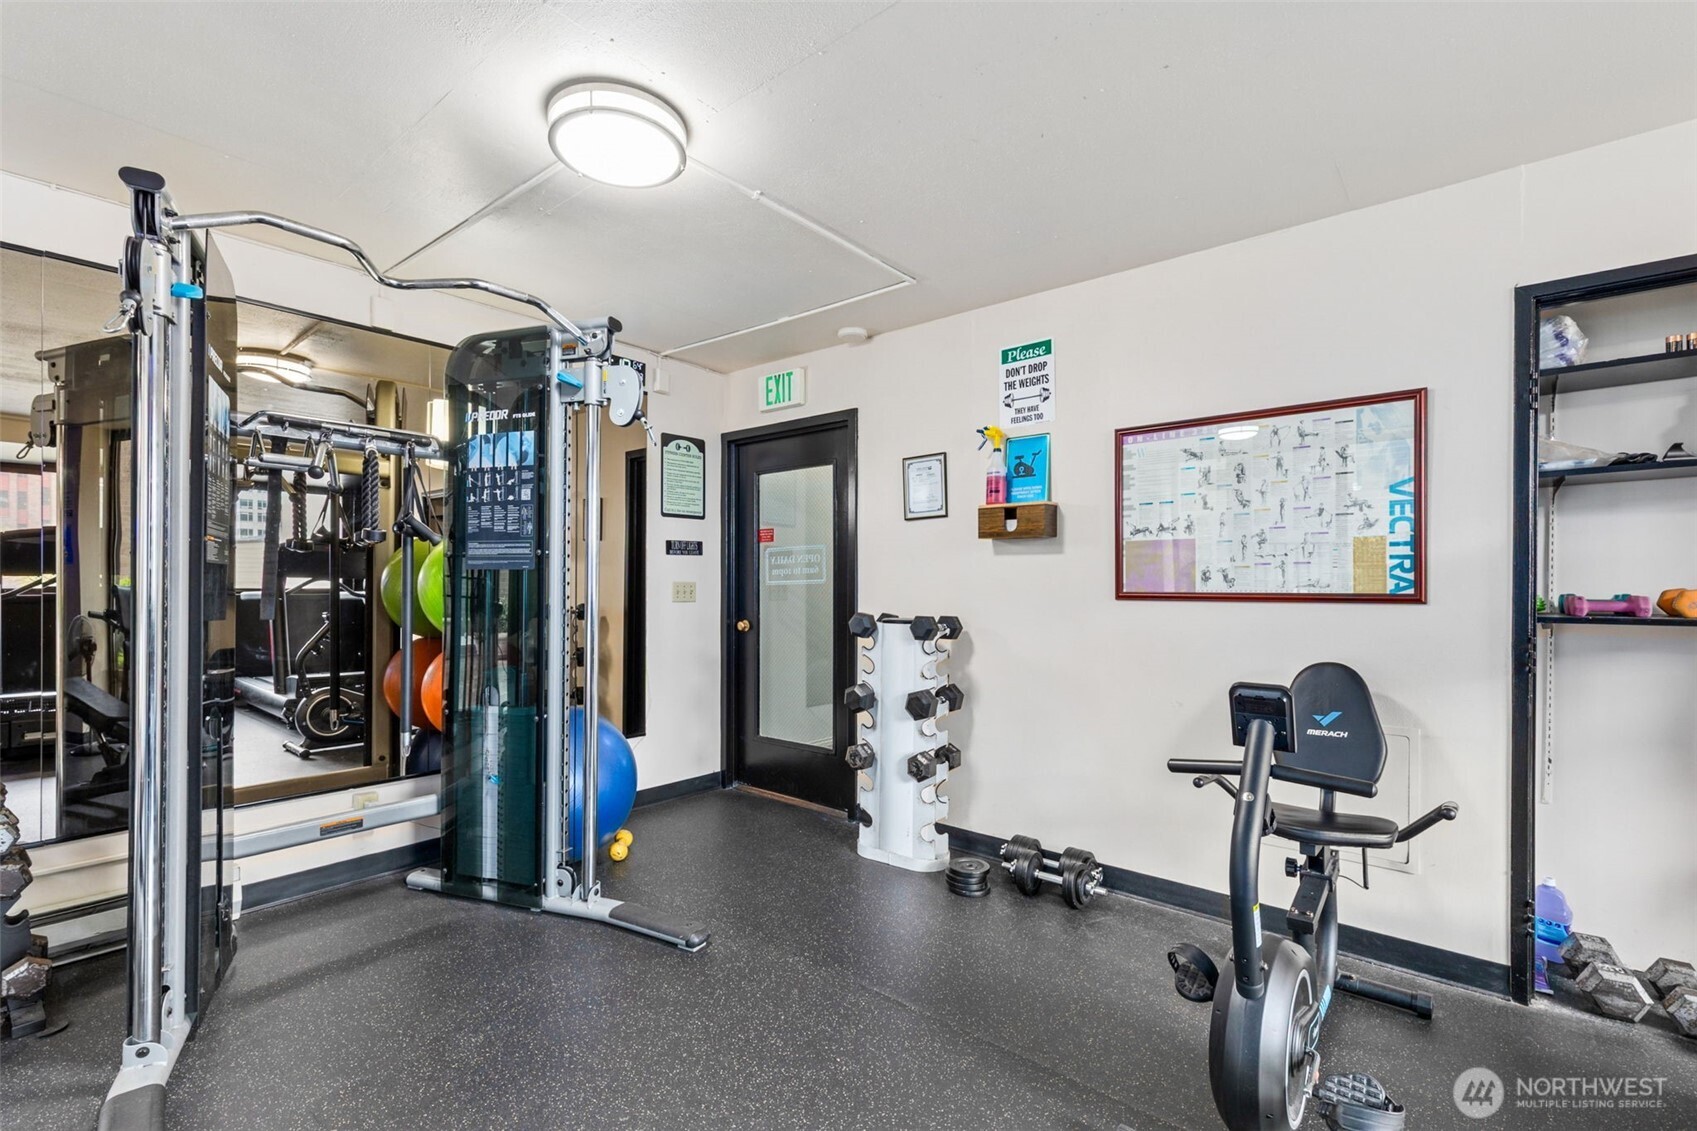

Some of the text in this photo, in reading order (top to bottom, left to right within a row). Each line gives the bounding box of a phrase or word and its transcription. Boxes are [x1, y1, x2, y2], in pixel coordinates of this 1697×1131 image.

[1007, 345, 1047, 363] Please
[1005, 361, 1048, 378] DON'T DROP
[766, 371, 793, 406] EXIT
[1004, 374, 1050, 391] THE WEIGHTS
[1011, 412, 1044, 424] FEELINGS TOO
[1015, 404, 1039, 415] THEY HAVE
[1389, 476, 1415, 595] VECTRA
[1306, 728, 1348, 737] MERACH
